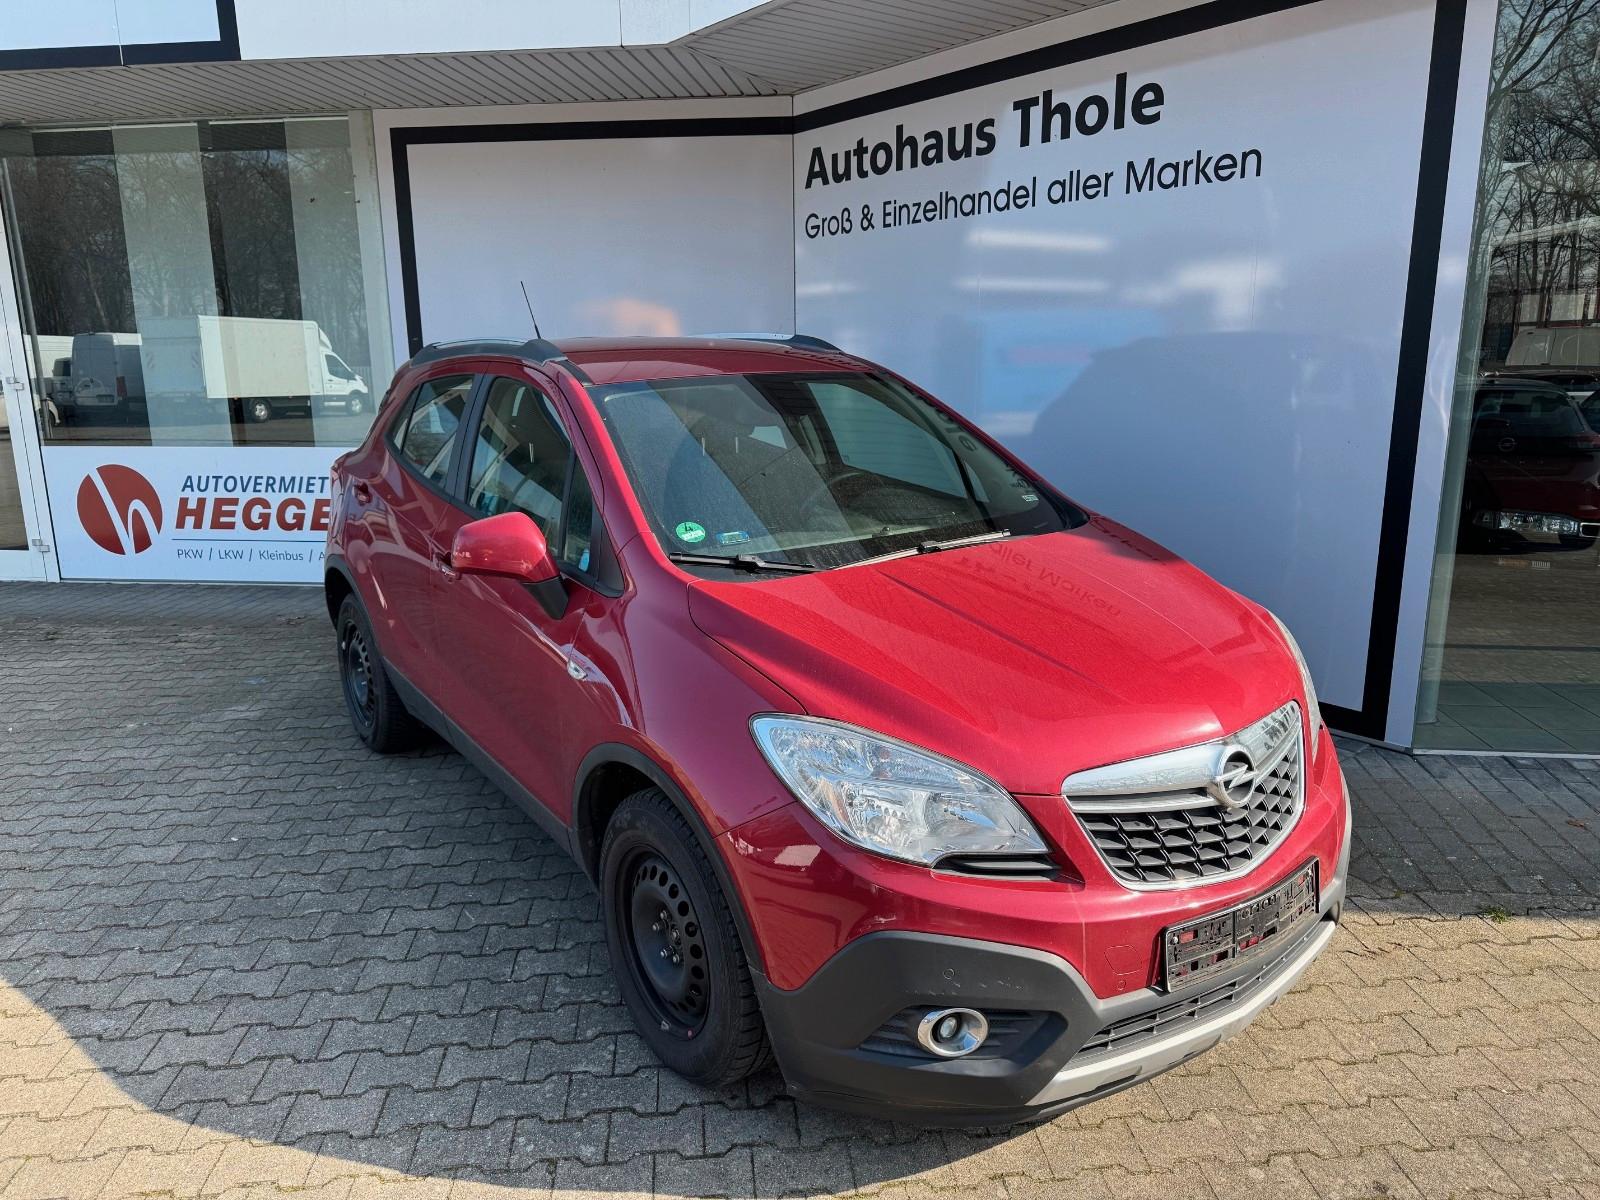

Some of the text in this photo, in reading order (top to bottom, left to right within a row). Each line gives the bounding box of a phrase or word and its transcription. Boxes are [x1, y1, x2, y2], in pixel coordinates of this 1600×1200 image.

[804, 71, 1165, 190] Autohaus Thole
[804, 148, 1263, 240] Groß & Einzelhandel aller Marken
[180, 475, 330, 494] AUTOVERMIET
[177, 548, 204, 560] PKW
[218, 549, 244, 560] LKW
[258, 549, 304, 561] Kleinbus
